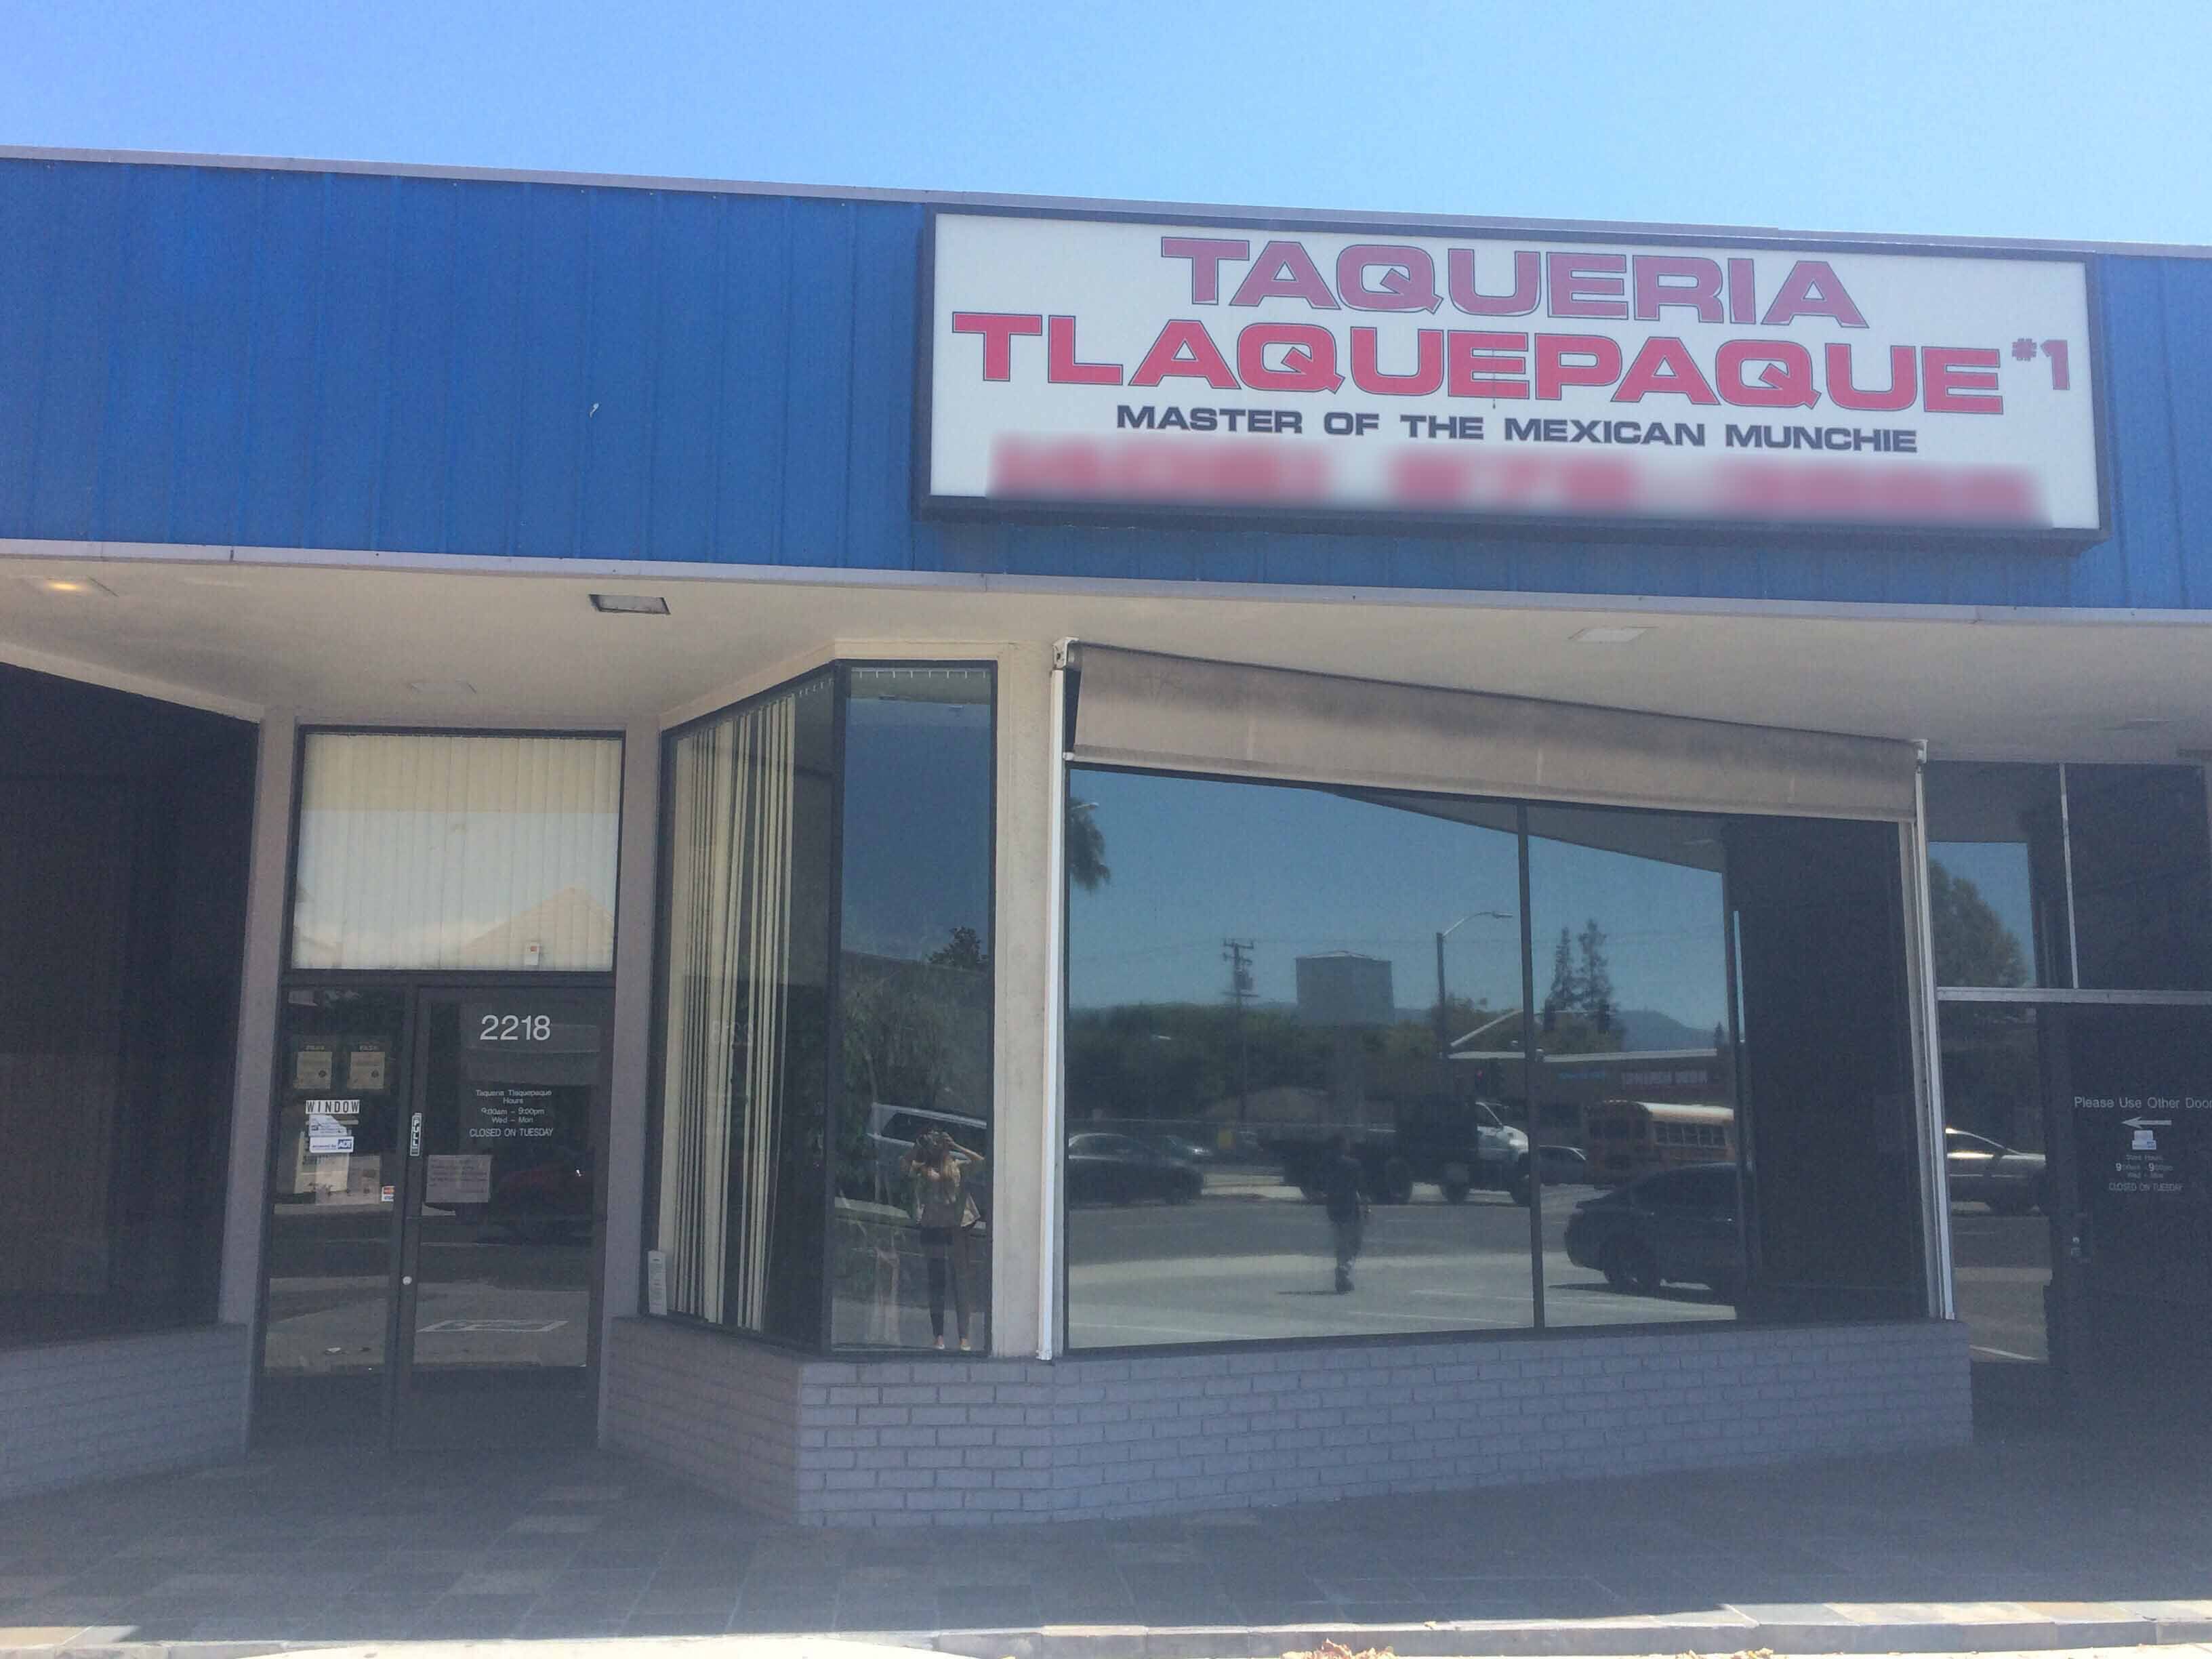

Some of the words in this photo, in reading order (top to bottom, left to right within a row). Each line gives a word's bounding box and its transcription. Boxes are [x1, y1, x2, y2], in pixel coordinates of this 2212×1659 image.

[1161, 237, 1869, 328] TAQUERIA
[952, 311, 2004, 415] TLAQUEPAQUE
[2011, 337, 2070, 391] #1
[1116, 405, 1303, 434] MASTER
[1324, 411, 1380, 436] OF
[1400, 414, 1484, 441] THE
[1504, 417, 1706, 447] MEXICAN
[1725, 424, 1918, 453] MUNCHIE
[480, 1015, 550, 1040] 2218
[307, 1101, 359, 1112] WINDOW
[2074, 1096, 2114, 1109] Please
[2119, 1097, 2142, 1109] Use
[2147, 1097, 2180, 1109] Other
[469, 1128, 501, 1137] CLOSED
[504, 1128, 516, 1137] ON
[519, 1128, 554, 1137] TUESDAY
[338, 1140, 352, 1149] ADT
